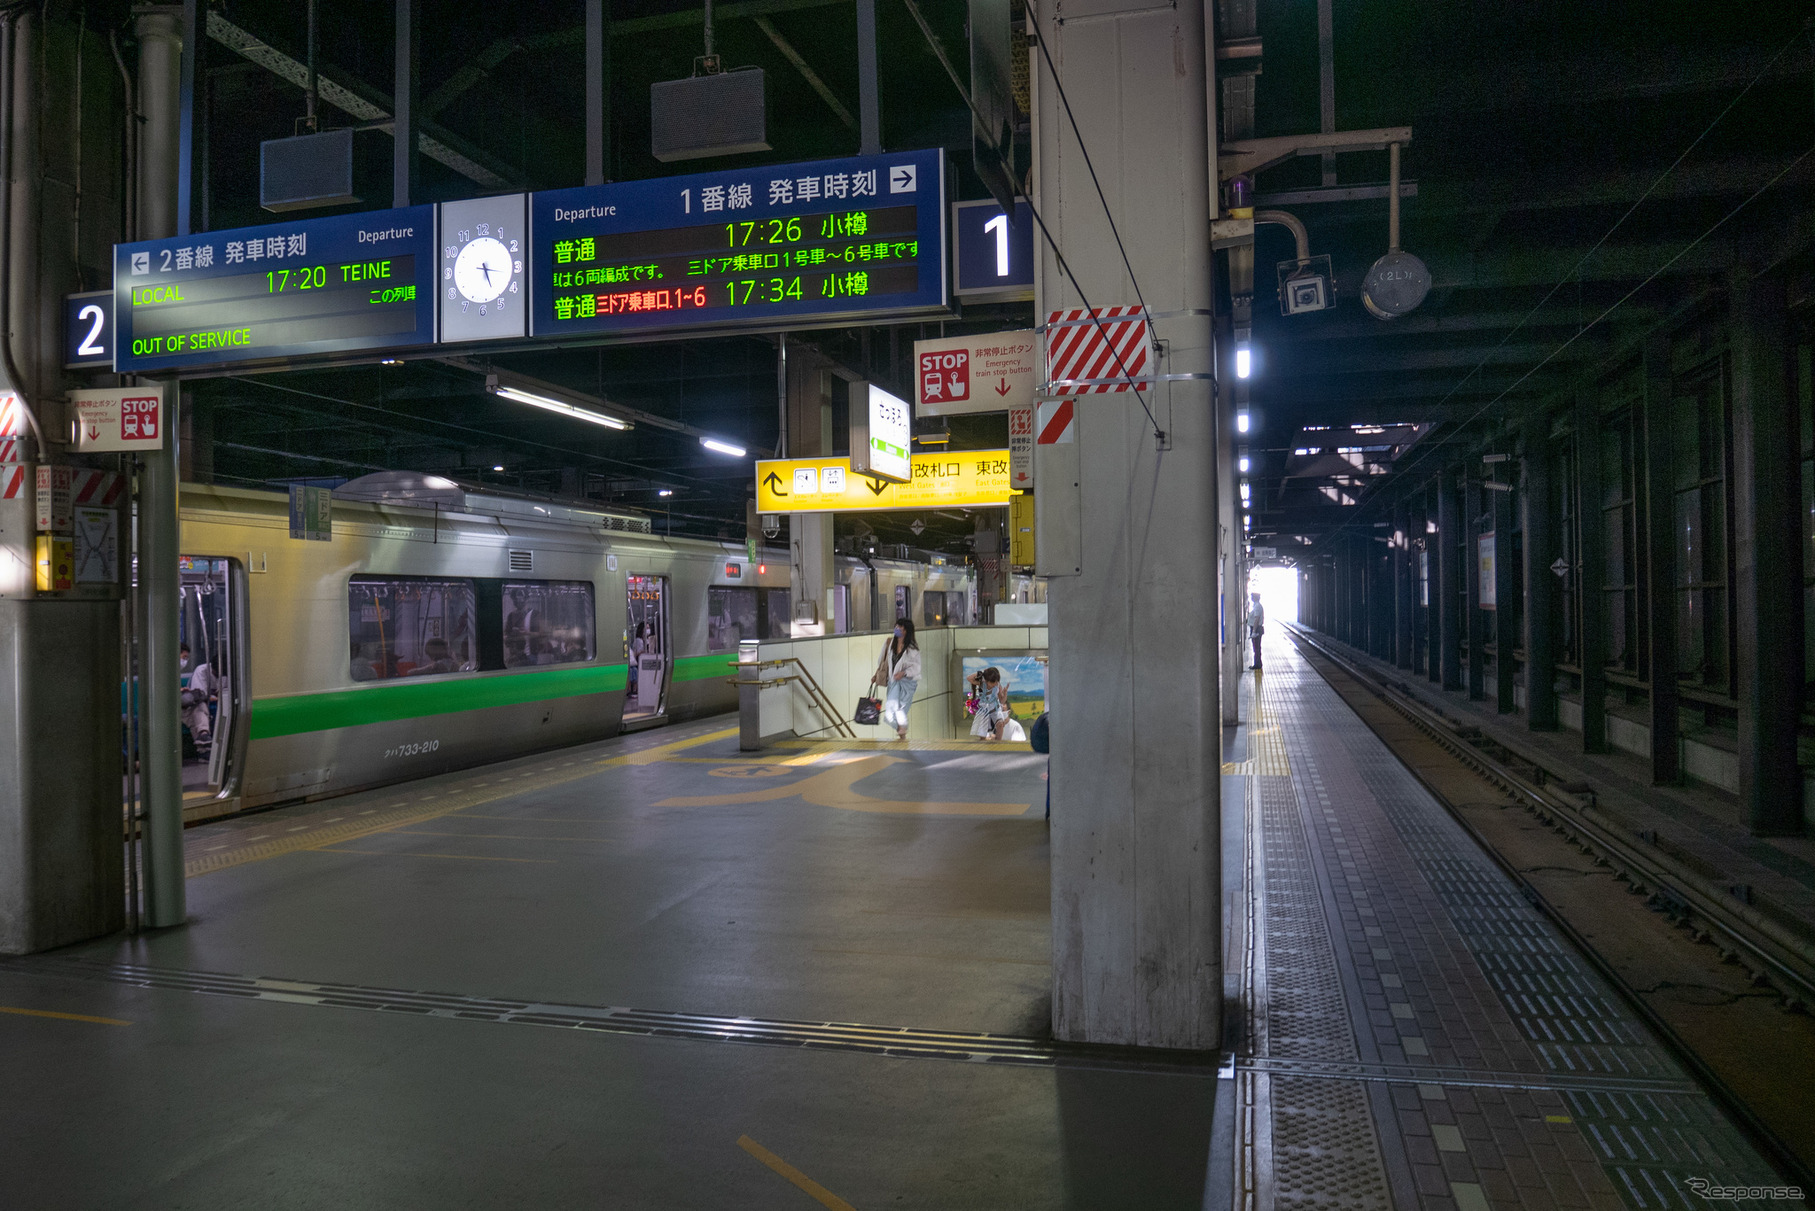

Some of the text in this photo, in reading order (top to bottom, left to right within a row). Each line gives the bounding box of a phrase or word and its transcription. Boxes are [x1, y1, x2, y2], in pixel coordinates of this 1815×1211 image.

[680, 169, 877, 214] 1番線 発車時刻
[555, 206, 617, 223] Departure
[358, 227, 413, 244] Departure
[458, 230, 470, 242] 11
[476, 223, 490, 236] 12
[498, 227, 504, 239] 1
[553, 211, 868, 264] 普通 17:26 小樽
[159, 232, 307, 272] 2番線 発車時刻
[445, 246, 458, 258] 10
[510, 240, 518, 252] 2
[984, 214, 1009, 277] 1
[514, 260, 522, 273] 3
[444, 267, 453, 280] 9
[132, 260, 391, 306] LOCAL 17:20 TEINE
[509, 281, 518, 293] 4
[448, 287, 456, 299] 8
[554, 293, 596, 320] 普通
[726, 276, 803, 307] 17:34
[821, 271, 868, 298] 小樽
[462, 301, 470, 313] 7
[479, 304, 487, 317] 6
[497, 298, 505, 310] 5
[78, 304, 104, 356] 2
[132, 328, 251, 355] OUT OF SERVICE
[975, 345, 1033, 358] 非常停止ボタン
[922, 353, 967, 371] STOP
[986, 359, 1021, 368] Emergency
[123, 400, 157, 413] STOP
[911, 460, 1010, 478] 改札口 東改
